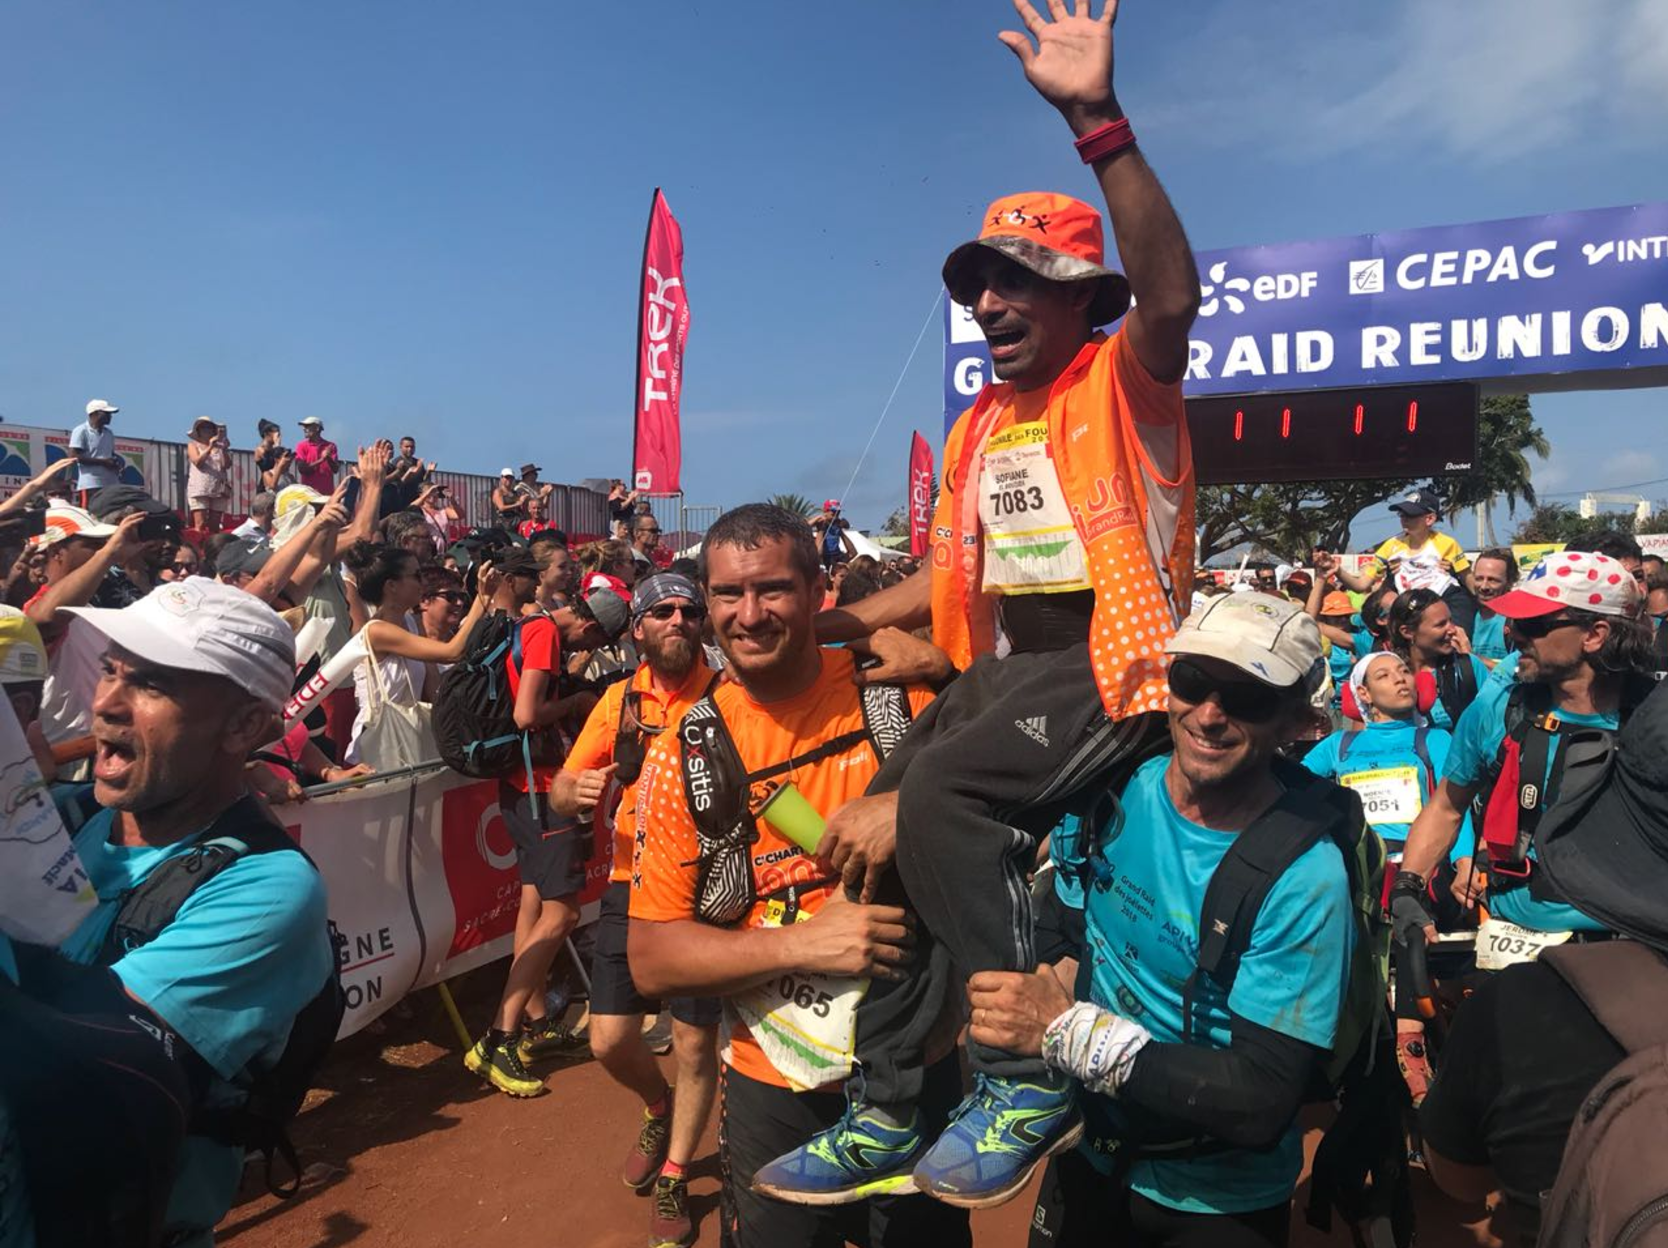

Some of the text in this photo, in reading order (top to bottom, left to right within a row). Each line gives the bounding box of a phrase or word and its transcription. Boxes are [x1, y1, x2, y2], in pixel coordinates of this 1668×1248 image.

[1396, 240, 1558, 290] CEPAC
[1183, 330, 1335, 381] RAID
[1361, 302, 1668, 369] REUNION
[994, 468, 1029, 484] SOFIANE
[989, 486, 1044, 516] 7083
[1014, 719, 1050, 748] adidas
[1121, 875, 1156, 907] Grand Raid
[1489, 934, 1542, 957] 7037
[779, 974, 834, 1018] 065
